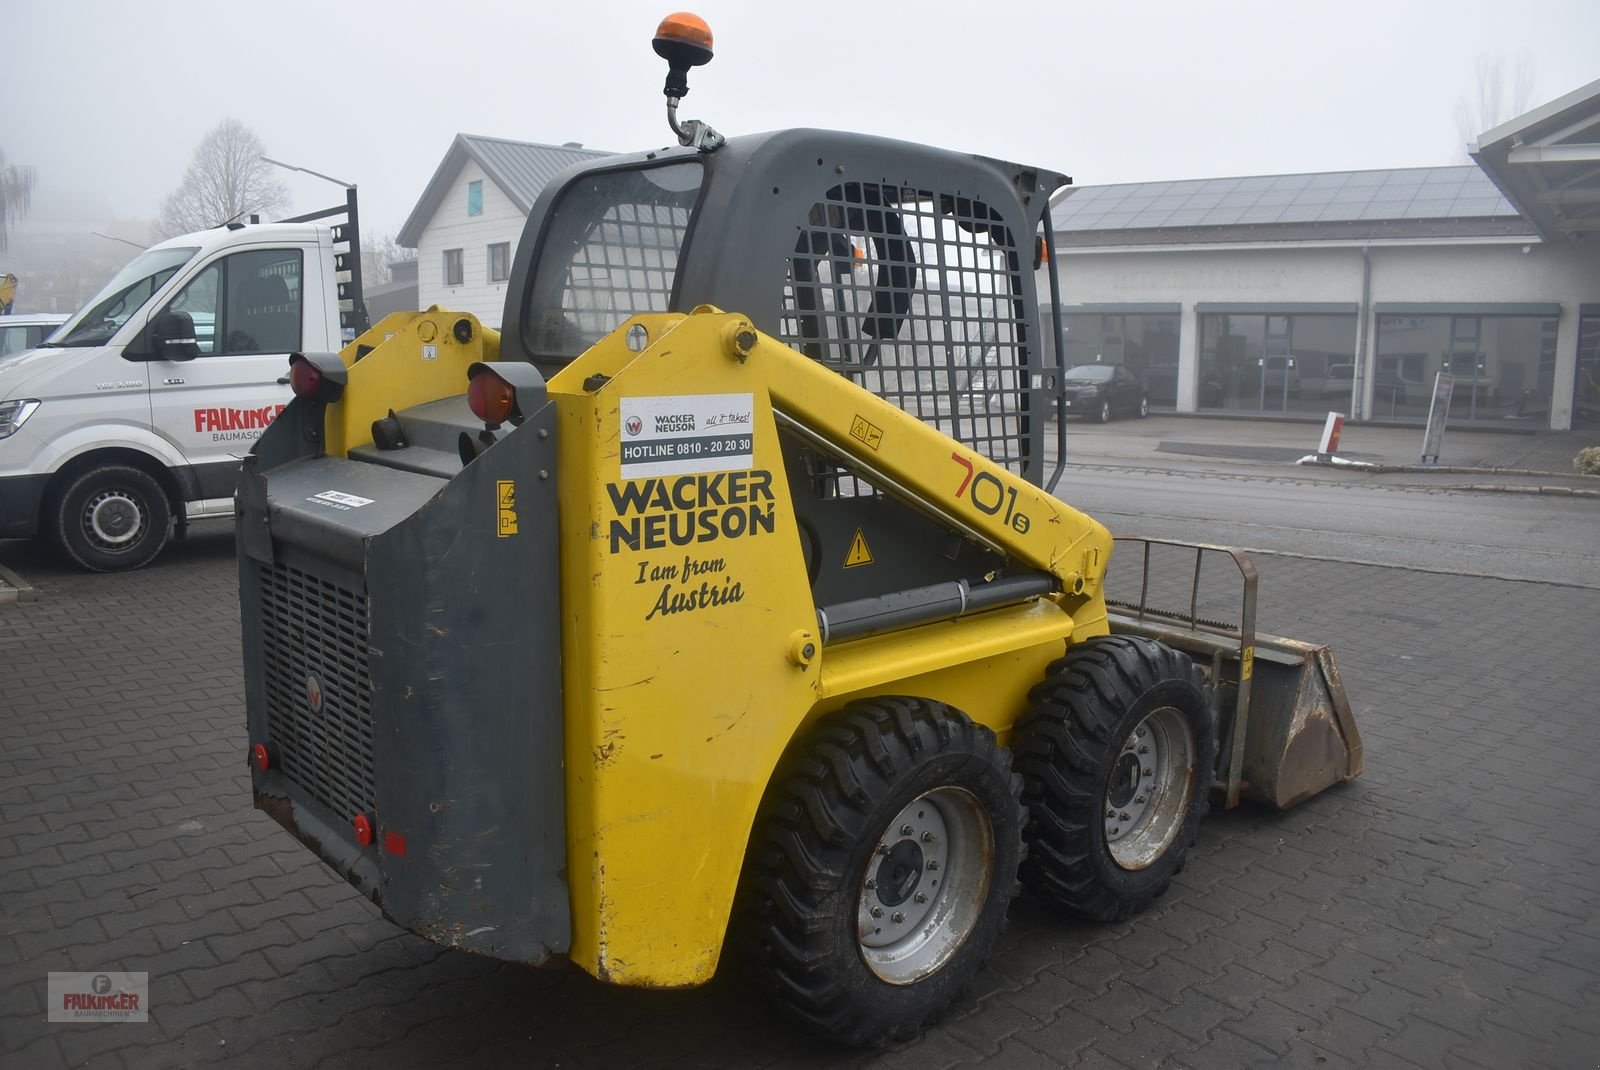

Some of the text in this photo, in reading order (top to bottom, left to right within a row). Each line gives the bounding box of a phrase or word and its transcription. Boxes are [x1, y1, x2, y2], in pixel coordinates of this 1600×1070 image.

[654, 414, 695, 424] WACKER
[655, 422, 696, 433] NEUSON
[705, 411, 751, 426] all it takes!
[212, 430, 264, 442] BAUMASC
[624, 444, 675, 459] HOTLINE
[677, 442, 702, 455] 0810
[710, 441, 723, 453] 20
[725, 440, 737, 452] 20
[739, 439, 751, 450] 30
[606, 470, 775, 516] WACKER
[610, 502, 775, 554] NEUSON
[634, 555, 726, 584] I am from
[645, 576, 745, 621] Austria
